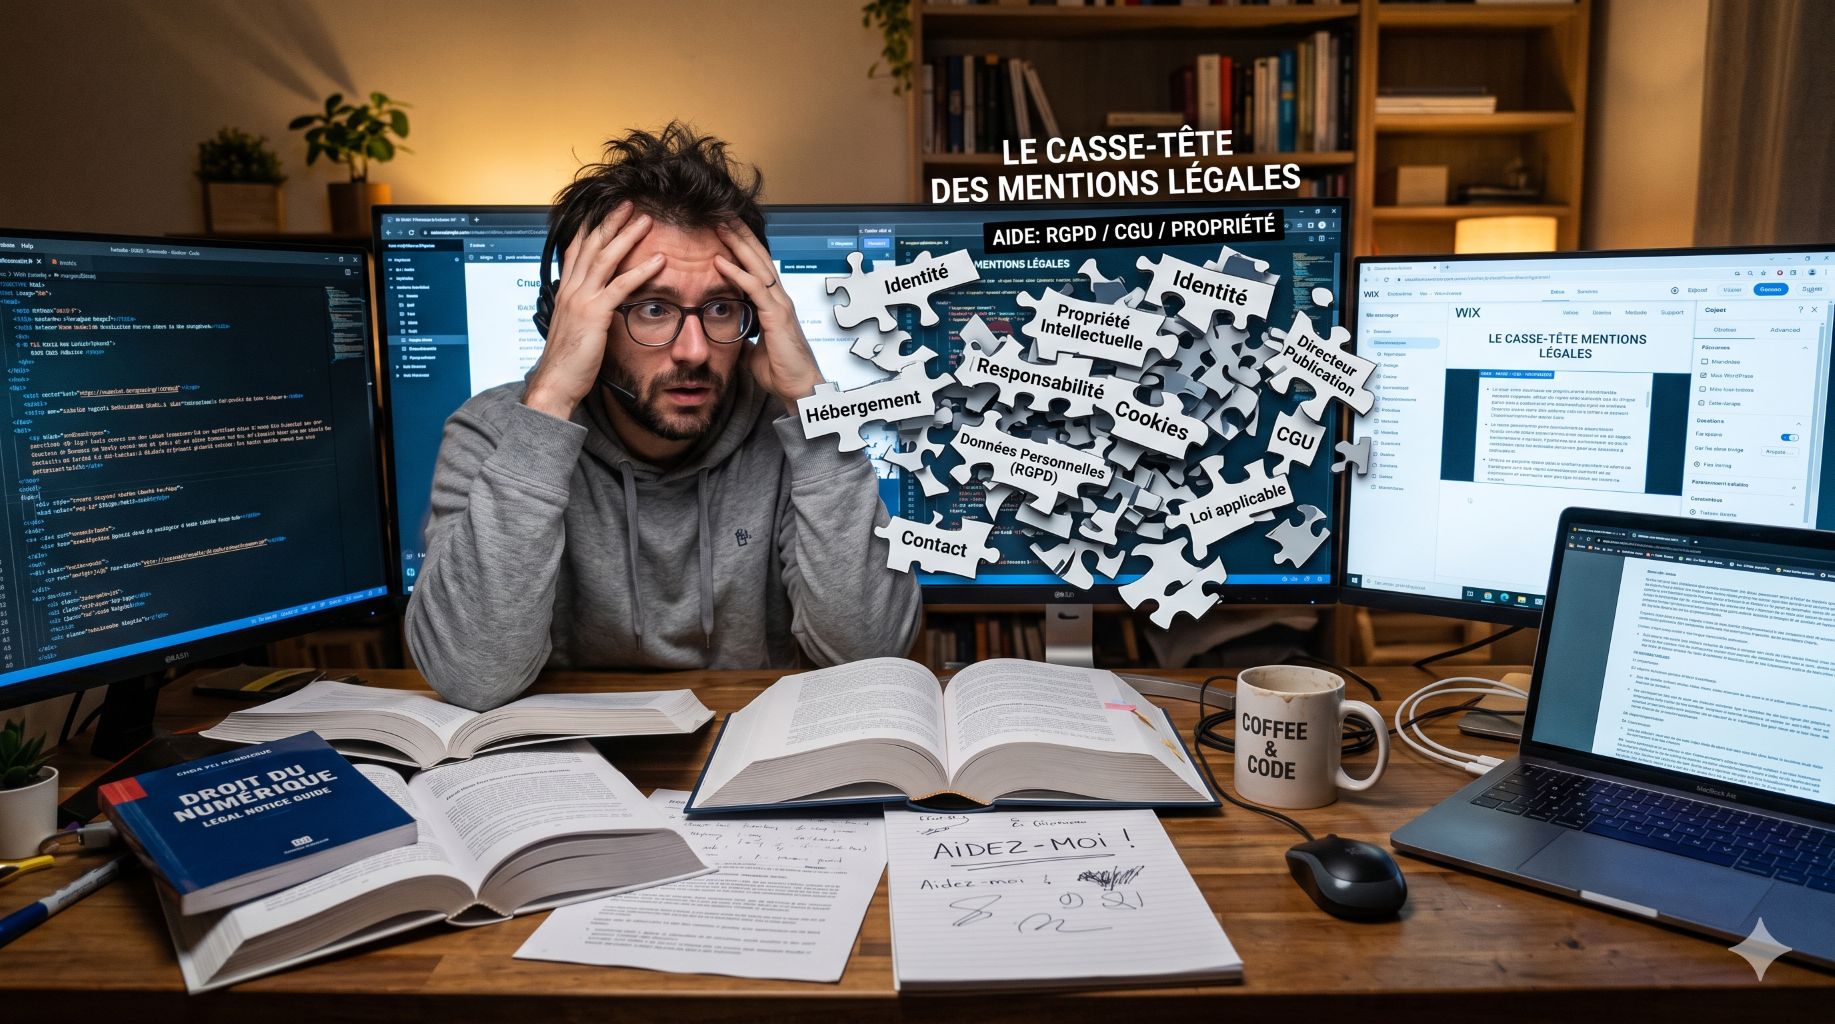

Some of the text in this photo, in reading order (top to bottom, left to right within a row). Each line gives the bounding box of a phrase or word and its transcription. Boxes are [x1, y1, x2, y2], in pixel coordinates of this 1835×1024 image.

[884, 263, 949, 295] Identité
[974, 257, 1071, 270] MENTIONS LÉGALES
[1172, 269, 1249, 307] Identité
[1363, 290, 1380, 298] WIX
[1056, 303, 1131, 331] Propriété
[1455, 307, 1481, 318] WIX
[1040, 318, 1144, 351] Intellectuelle
[1488, 331, 1647, 346] LE CASSE-TÊTE MENTIONS
[1296, 334, 1358, 378] Directeur
[1539, 346, 1593, 359] LÉGALES
[976, 357, 1105, 399] Responsabilité
[1283, 344, 1356, 398] Publication
[805, 389, 922, 424] Hébergement
[1114, 400, 1190, 441] Cookies
[1276, 425, 1316, 452] CGU
[959, 431, 1106, 480] Données Personnelles
[1010, 458, 1059, 487] (RGPD)
[1190, 482, 1287, 526] Loi applicable
[901, 529, 968, 559] Contact
[1242, 712, 1308, 740] COFFEE
[1264, 740, 1277, 758] &
[1248, 754, 1296, 780] CODE
[173, 770, 338, 823] NUMÉRIQUE
[177, 764, 306, 807] DROIT DU
[202, 787, 332, 828] LEGAL NOTICE GUIDE
[1122, 828, 1136, 848] !
